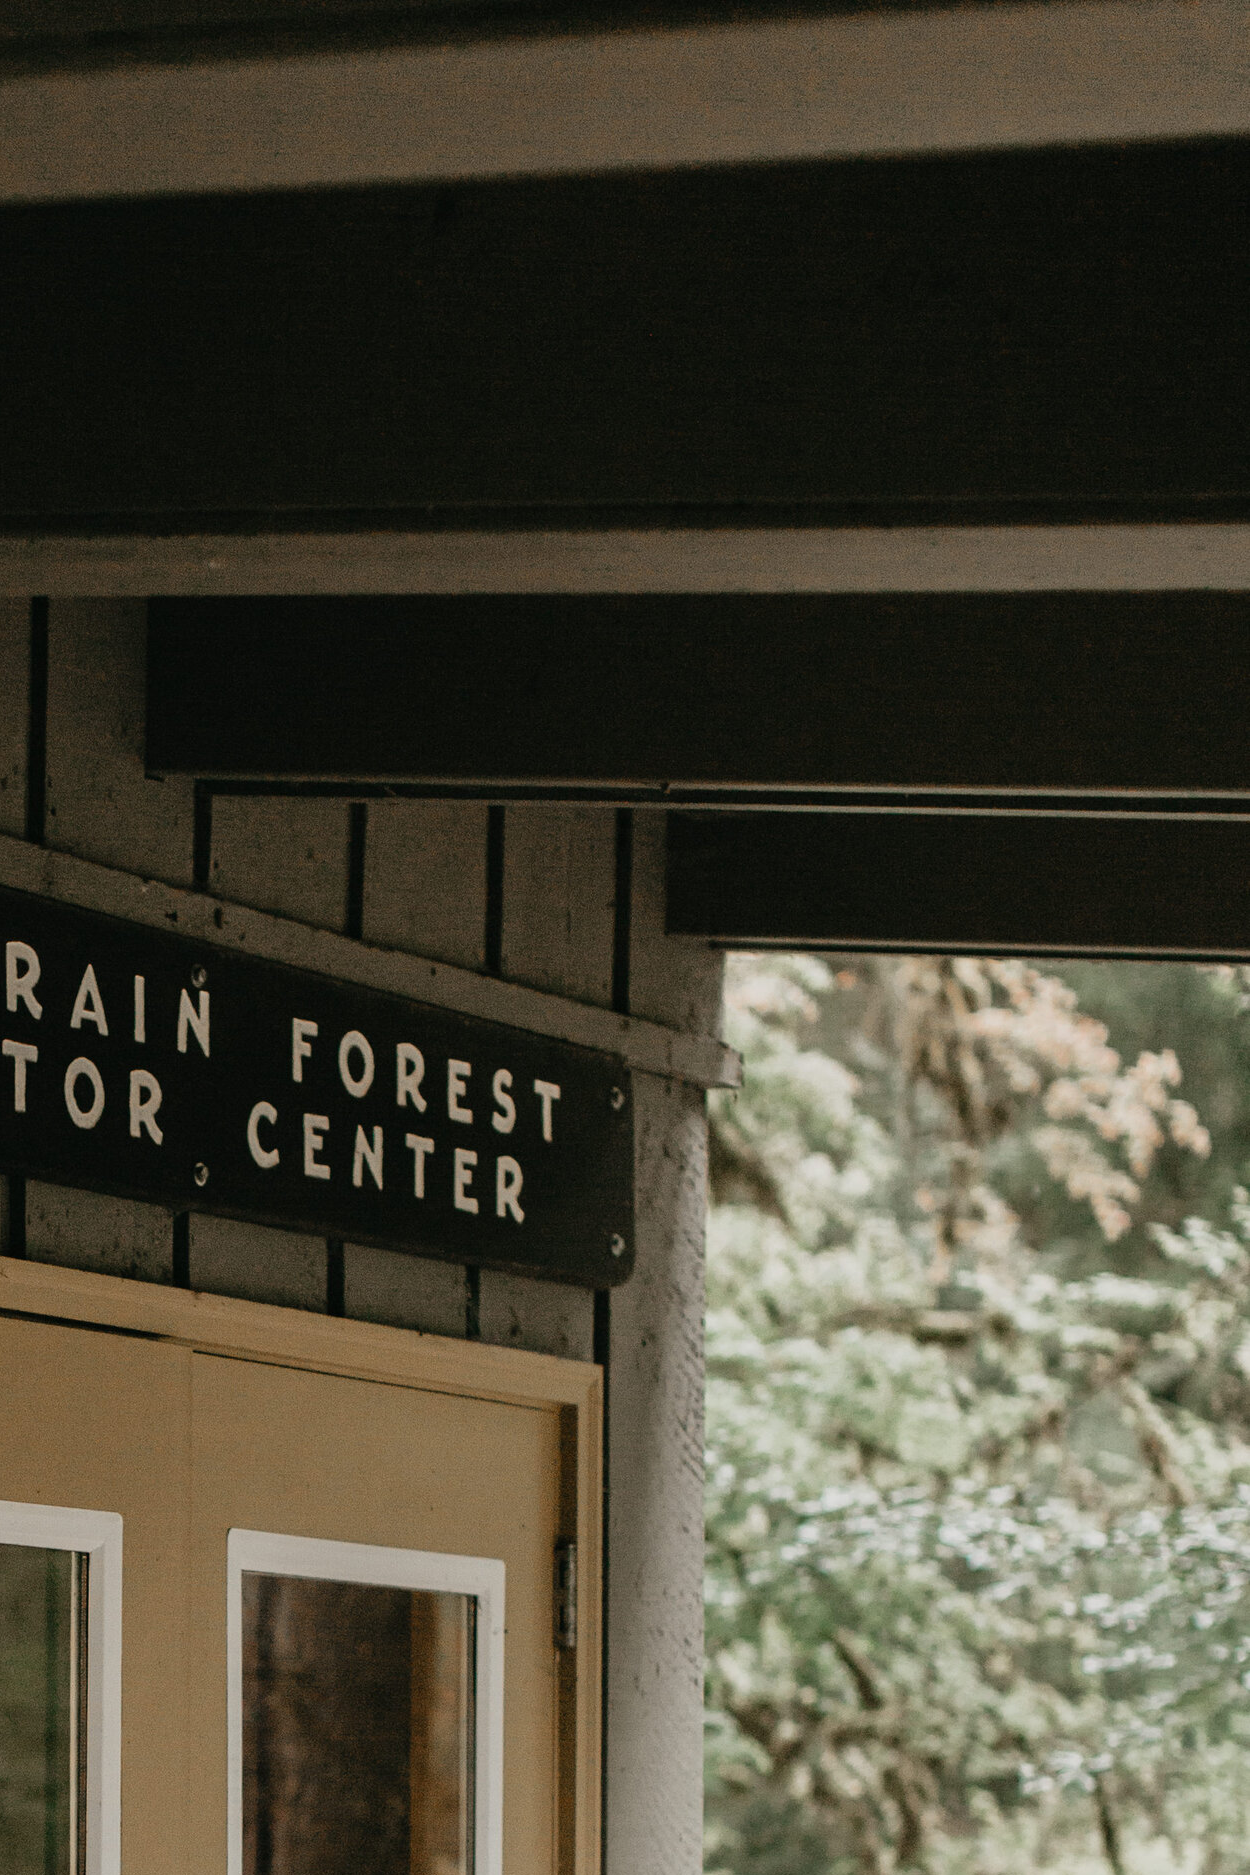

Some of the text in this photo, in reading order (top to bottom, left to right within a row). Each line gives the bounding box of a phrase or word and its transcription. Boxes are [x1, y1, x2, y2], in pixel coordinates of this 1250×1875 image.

[5, 940, 211, 1059] RAIN
[291, 1016, 561, 1144] FOREST
[247, 1100, 525, 1226] CENTER
